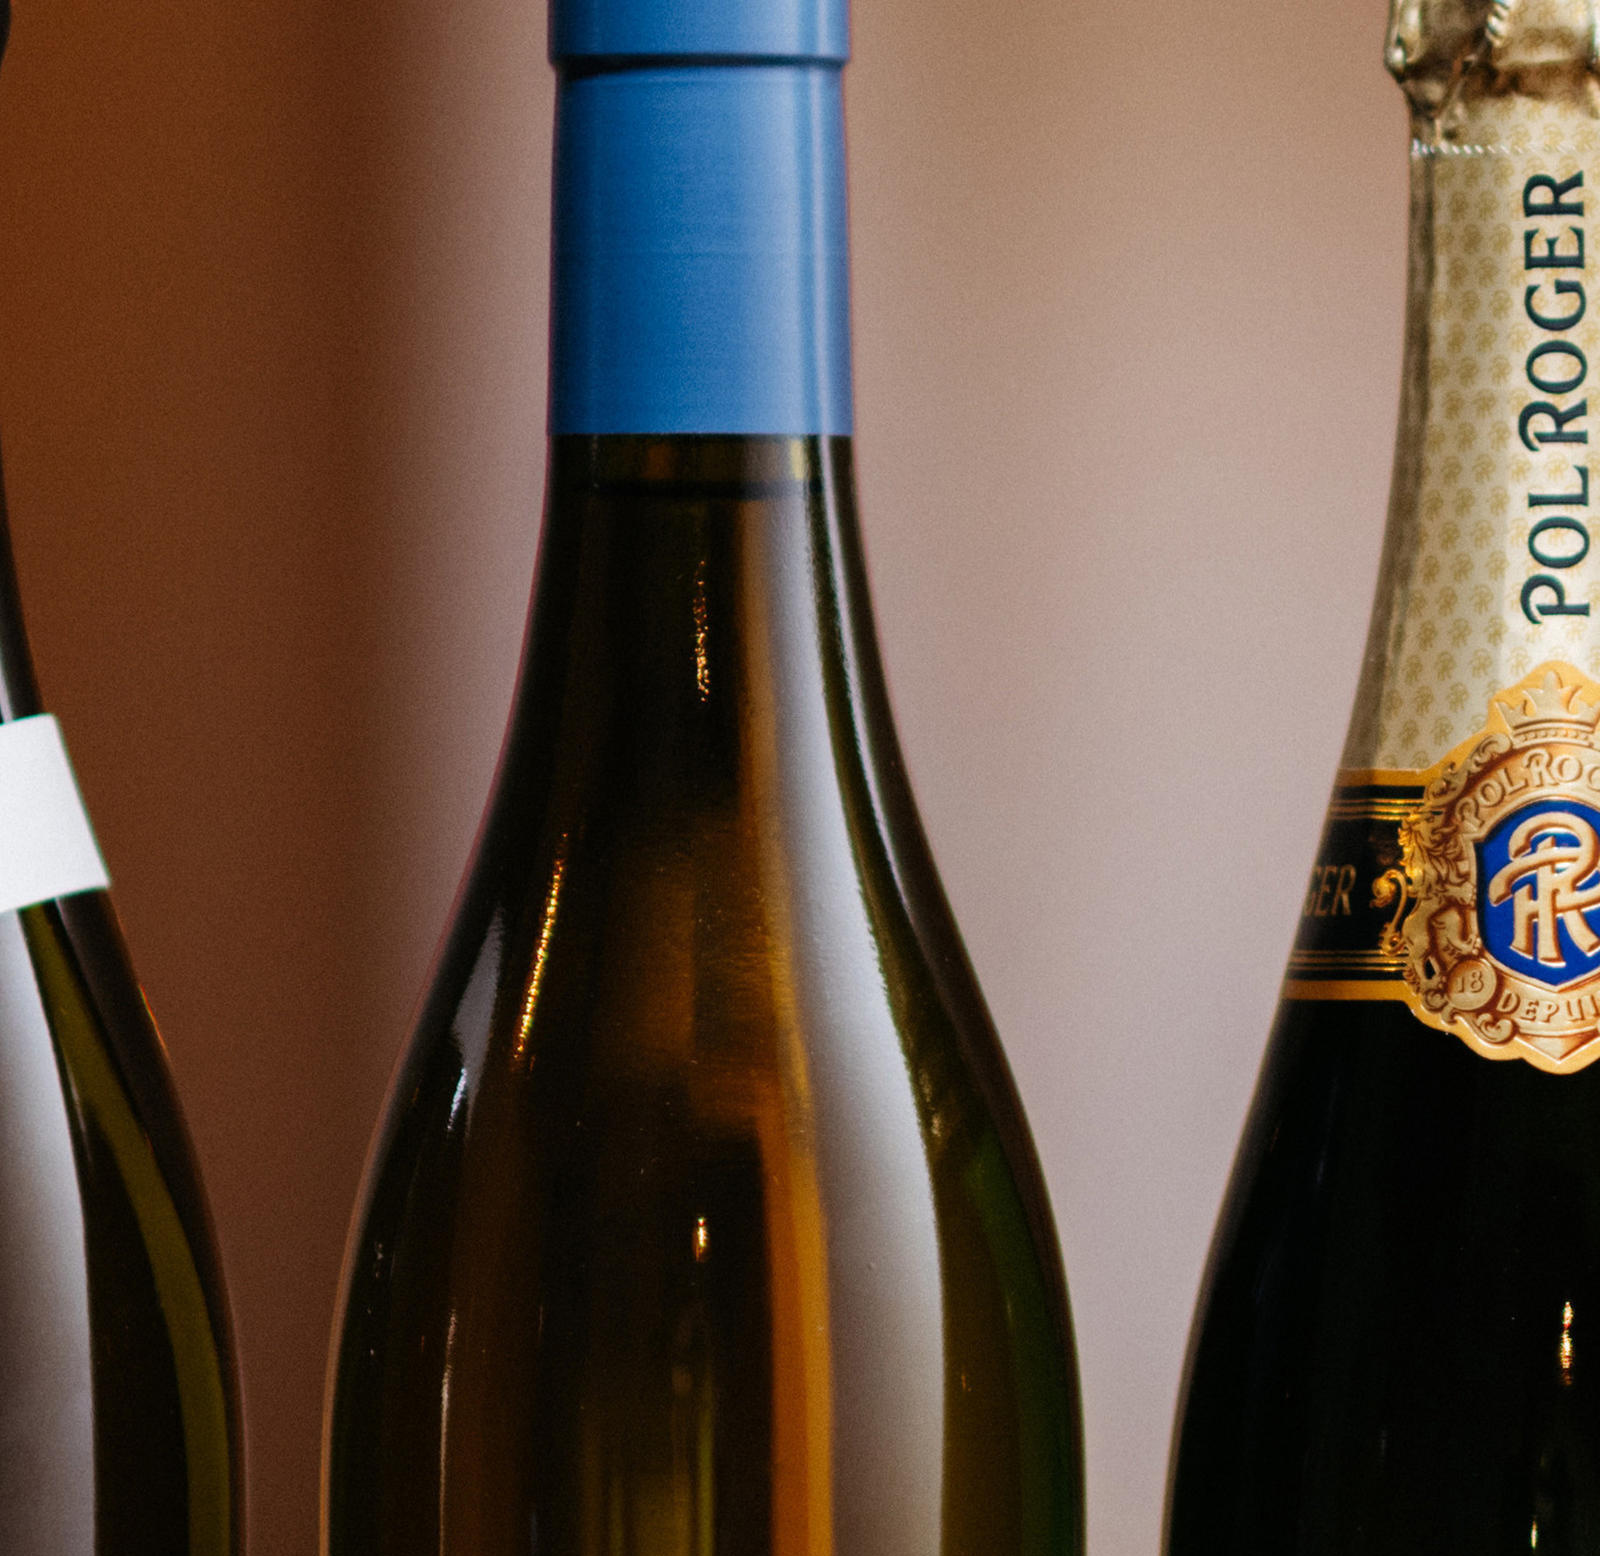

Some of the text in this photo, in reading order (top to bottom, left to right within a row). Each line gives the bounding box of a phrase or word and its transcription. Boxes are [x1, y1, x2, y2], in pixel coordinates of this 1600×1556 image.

[1518, 169, 1590, 625] POL ROGER
[1455, 762, 1531, 833] POL
[1455, 966, 1485, 994] 18
